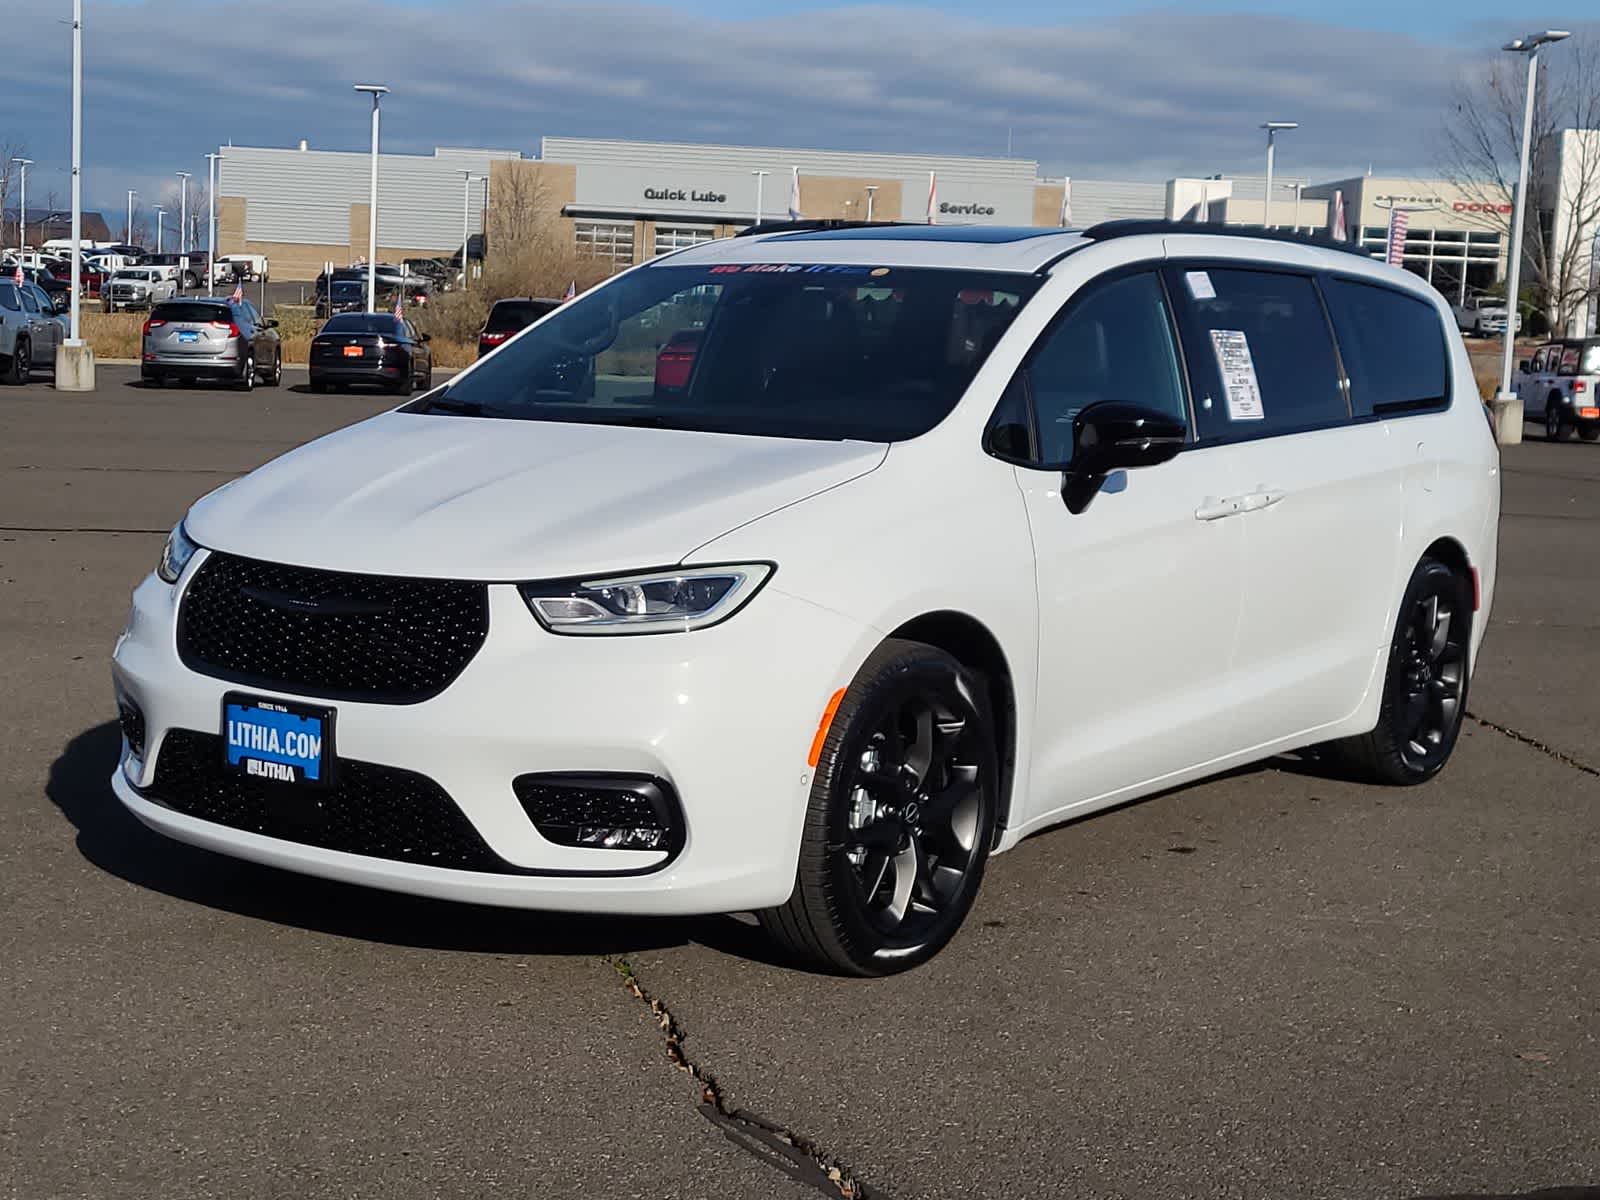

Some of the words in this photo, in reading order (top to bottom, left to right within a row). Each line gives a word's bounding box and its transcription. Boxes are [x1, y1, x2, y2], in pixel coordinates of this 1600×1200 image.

[644, 188, 687, 200] Quick
[691, 190, 727, 203] Lube
[939, 202, 995, 215] Service
[1452, 202, 1512, 214] DODG
[229, 720, 321, 759] LITHIA.COM
